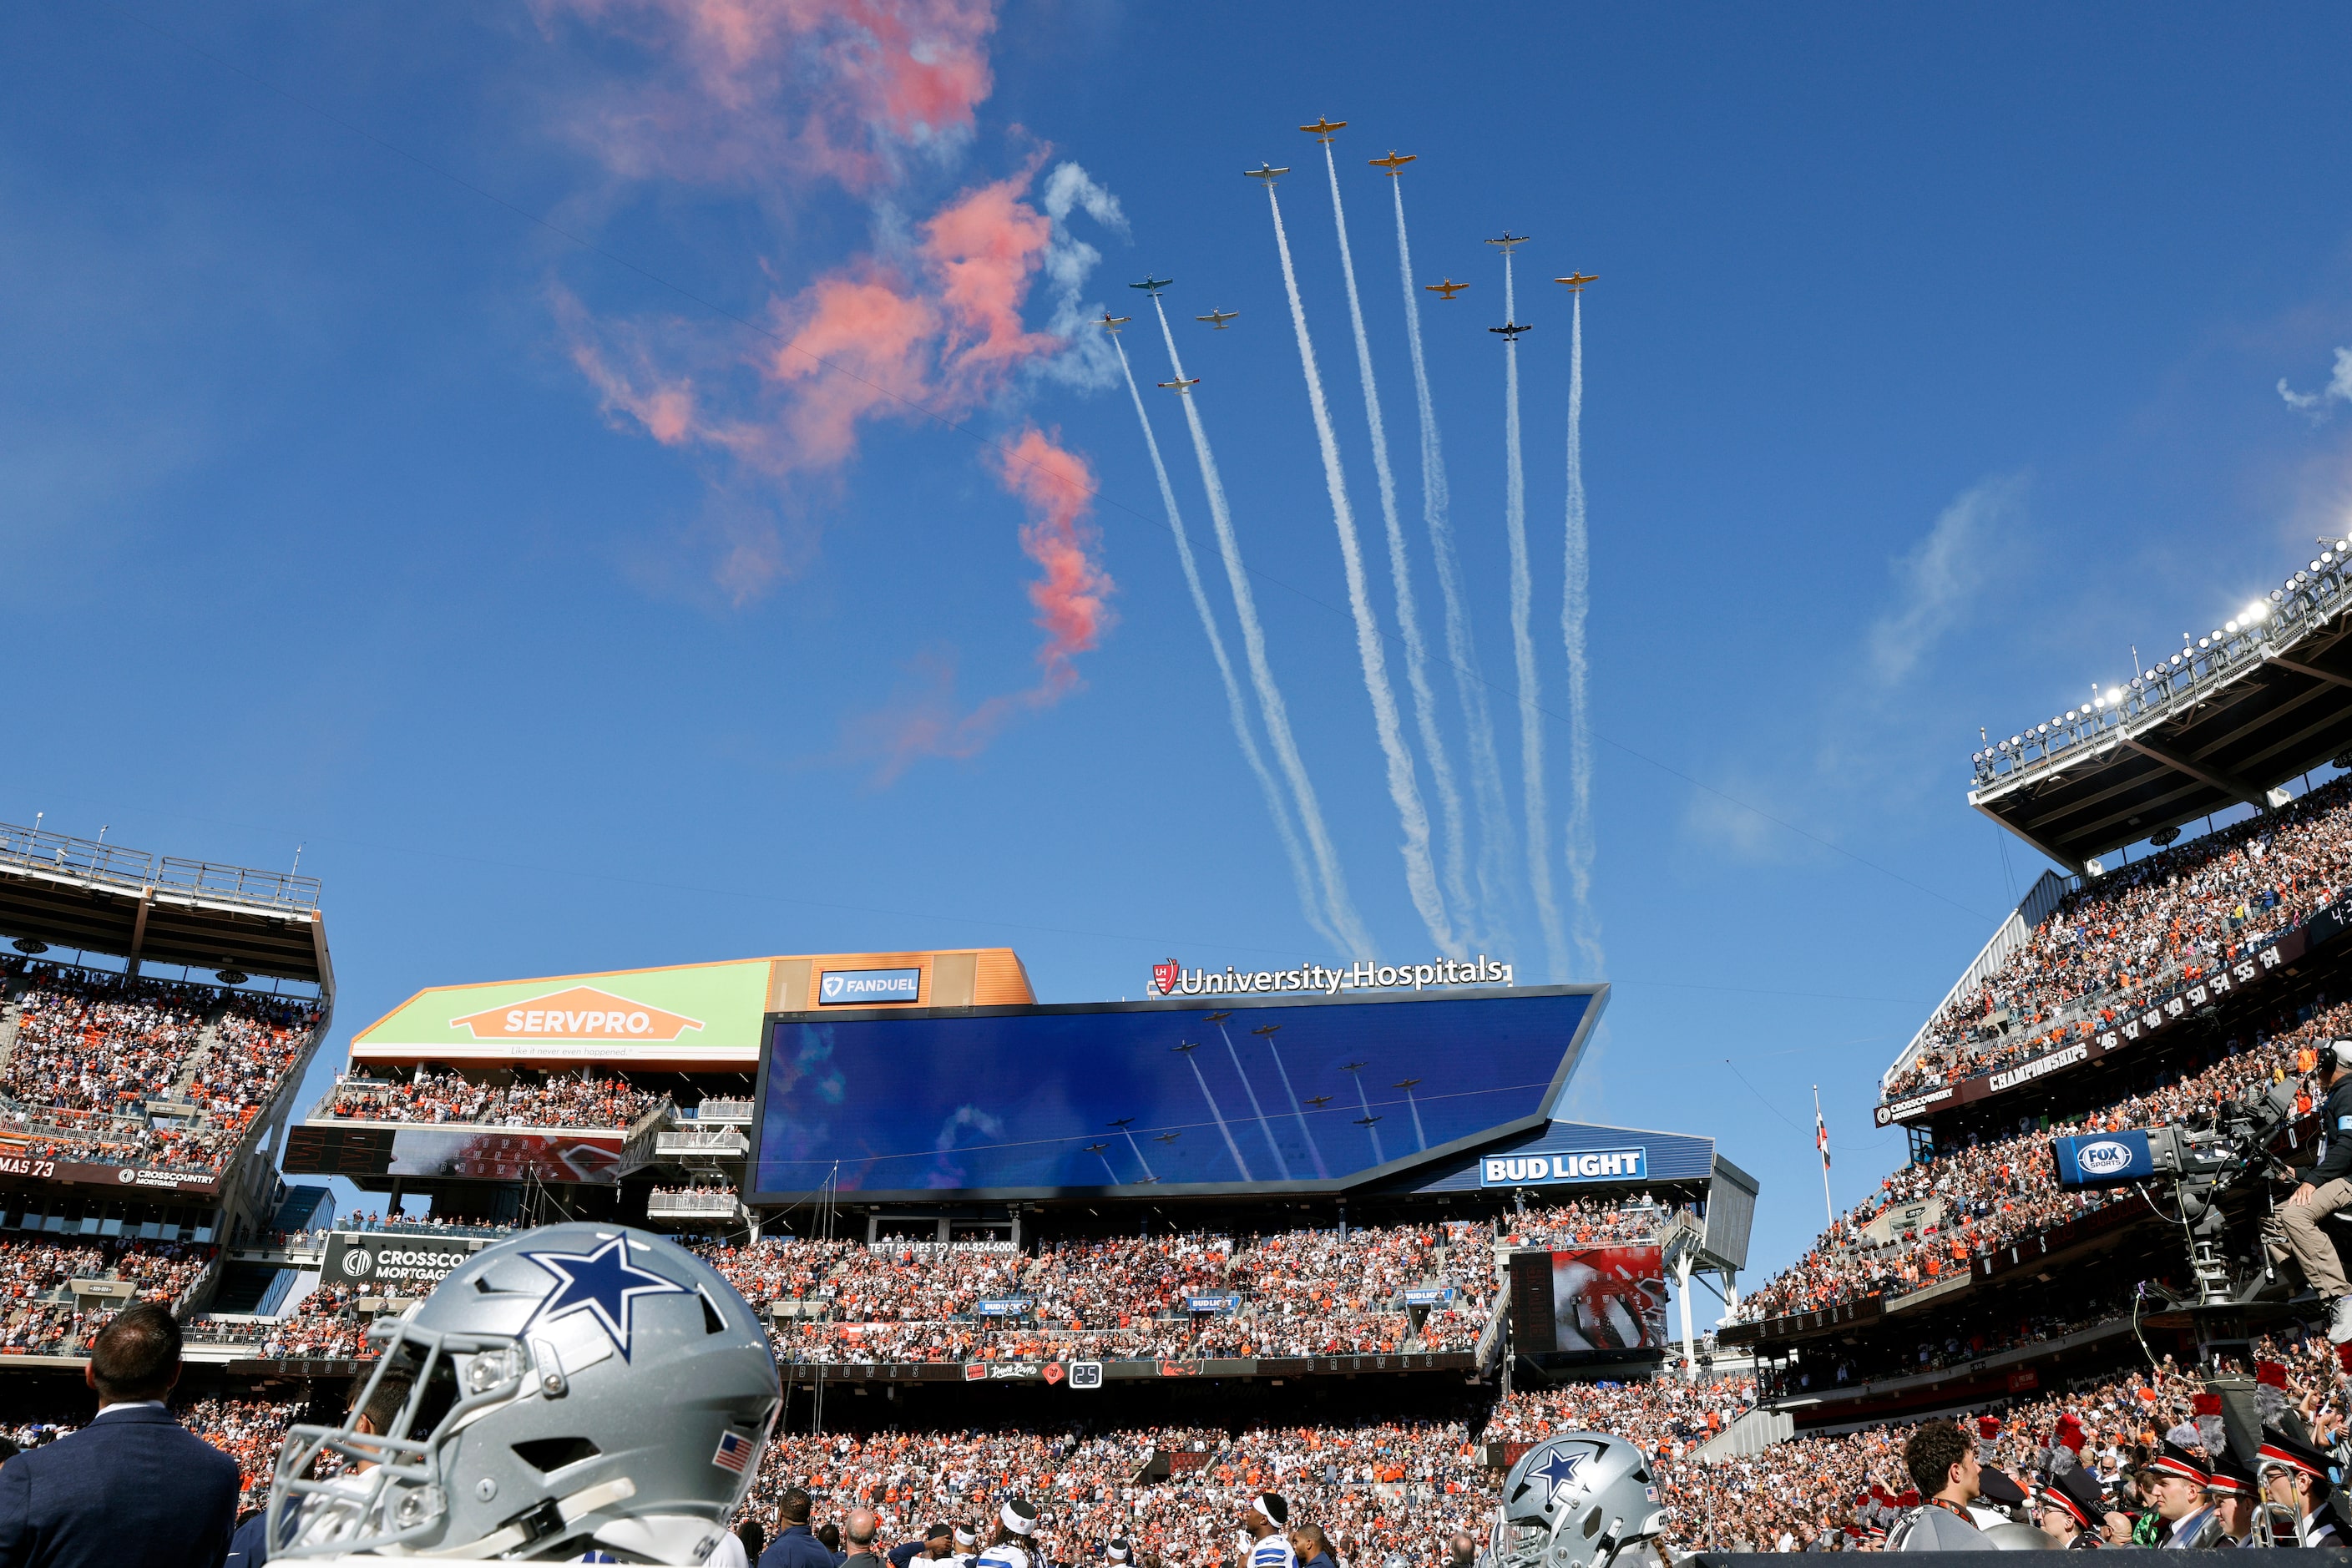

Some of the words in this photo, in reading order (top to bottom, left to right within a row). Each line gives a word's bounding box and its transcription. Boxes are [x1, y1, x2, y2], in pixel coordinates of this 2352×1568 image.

[1156, 968, 1166, 976] UH
[1181, 962, 1344, 994] University
[1353, 954, 1502, 990] Hospitals
[846, 979, 917, 993] FANDUEL
[1989, 1042, 2087, 1092] CHAMPIONSHIPS
[2096, 1030, 2118, 1050] '46
[2121, 1019, 2139, 1040] '47
[2142, 1009, 2162, 1029] '48
[2163, 997, 2184, 1018] '49
[2185, 984, 2208, 1007] '50
[2208, 973, 2231, 995] '54
[2233, 959, 2255, 983] '55
[2258, 945, 2281, 969] '64
[510, 1046, 529, 1056] Like
[530, 1046, 536, 1056] it
[584, 1046, 628, 1058] happened.
[1890, 1087, 1954, 1113] CROSSCOUNTRY
[1891, 1105, 1927, 1121] MORTGAGE
[2088, 1146, 2120, 1162] FOX
[32, 1161, 55, 1178] 73
[1486, 1158, 1549, 1182] BUD
[1552, 1152, 1640, 1179] LIGHT
[2090, 1159, 2121, 1168] SPORTS
[135, 1178, 179, 1188] MORTGAGE
[137, 1170, 215, 1185] CROSSCOUNTRY
[868, 1243, 895, 1253] TEXT
[897, 1242, 931, 1252] ISSUES
[933, 1242, 948, 1252] TO
[951, 1242, 1018, 1253] 440-824-6000
[375, 1266, 452, 1281] MORTGAG
[1405, 1292, 1422, 1300] BUD
[1759, 1304, 1854, 1338] BROWNS
[278, 1361, 359, 1374] BROW
[798, 1365, 919, 1378] BROWNS
[1307, 1357, 1433, 1372] BROWNS
[1075, 1366, 1096, 1384] 25
